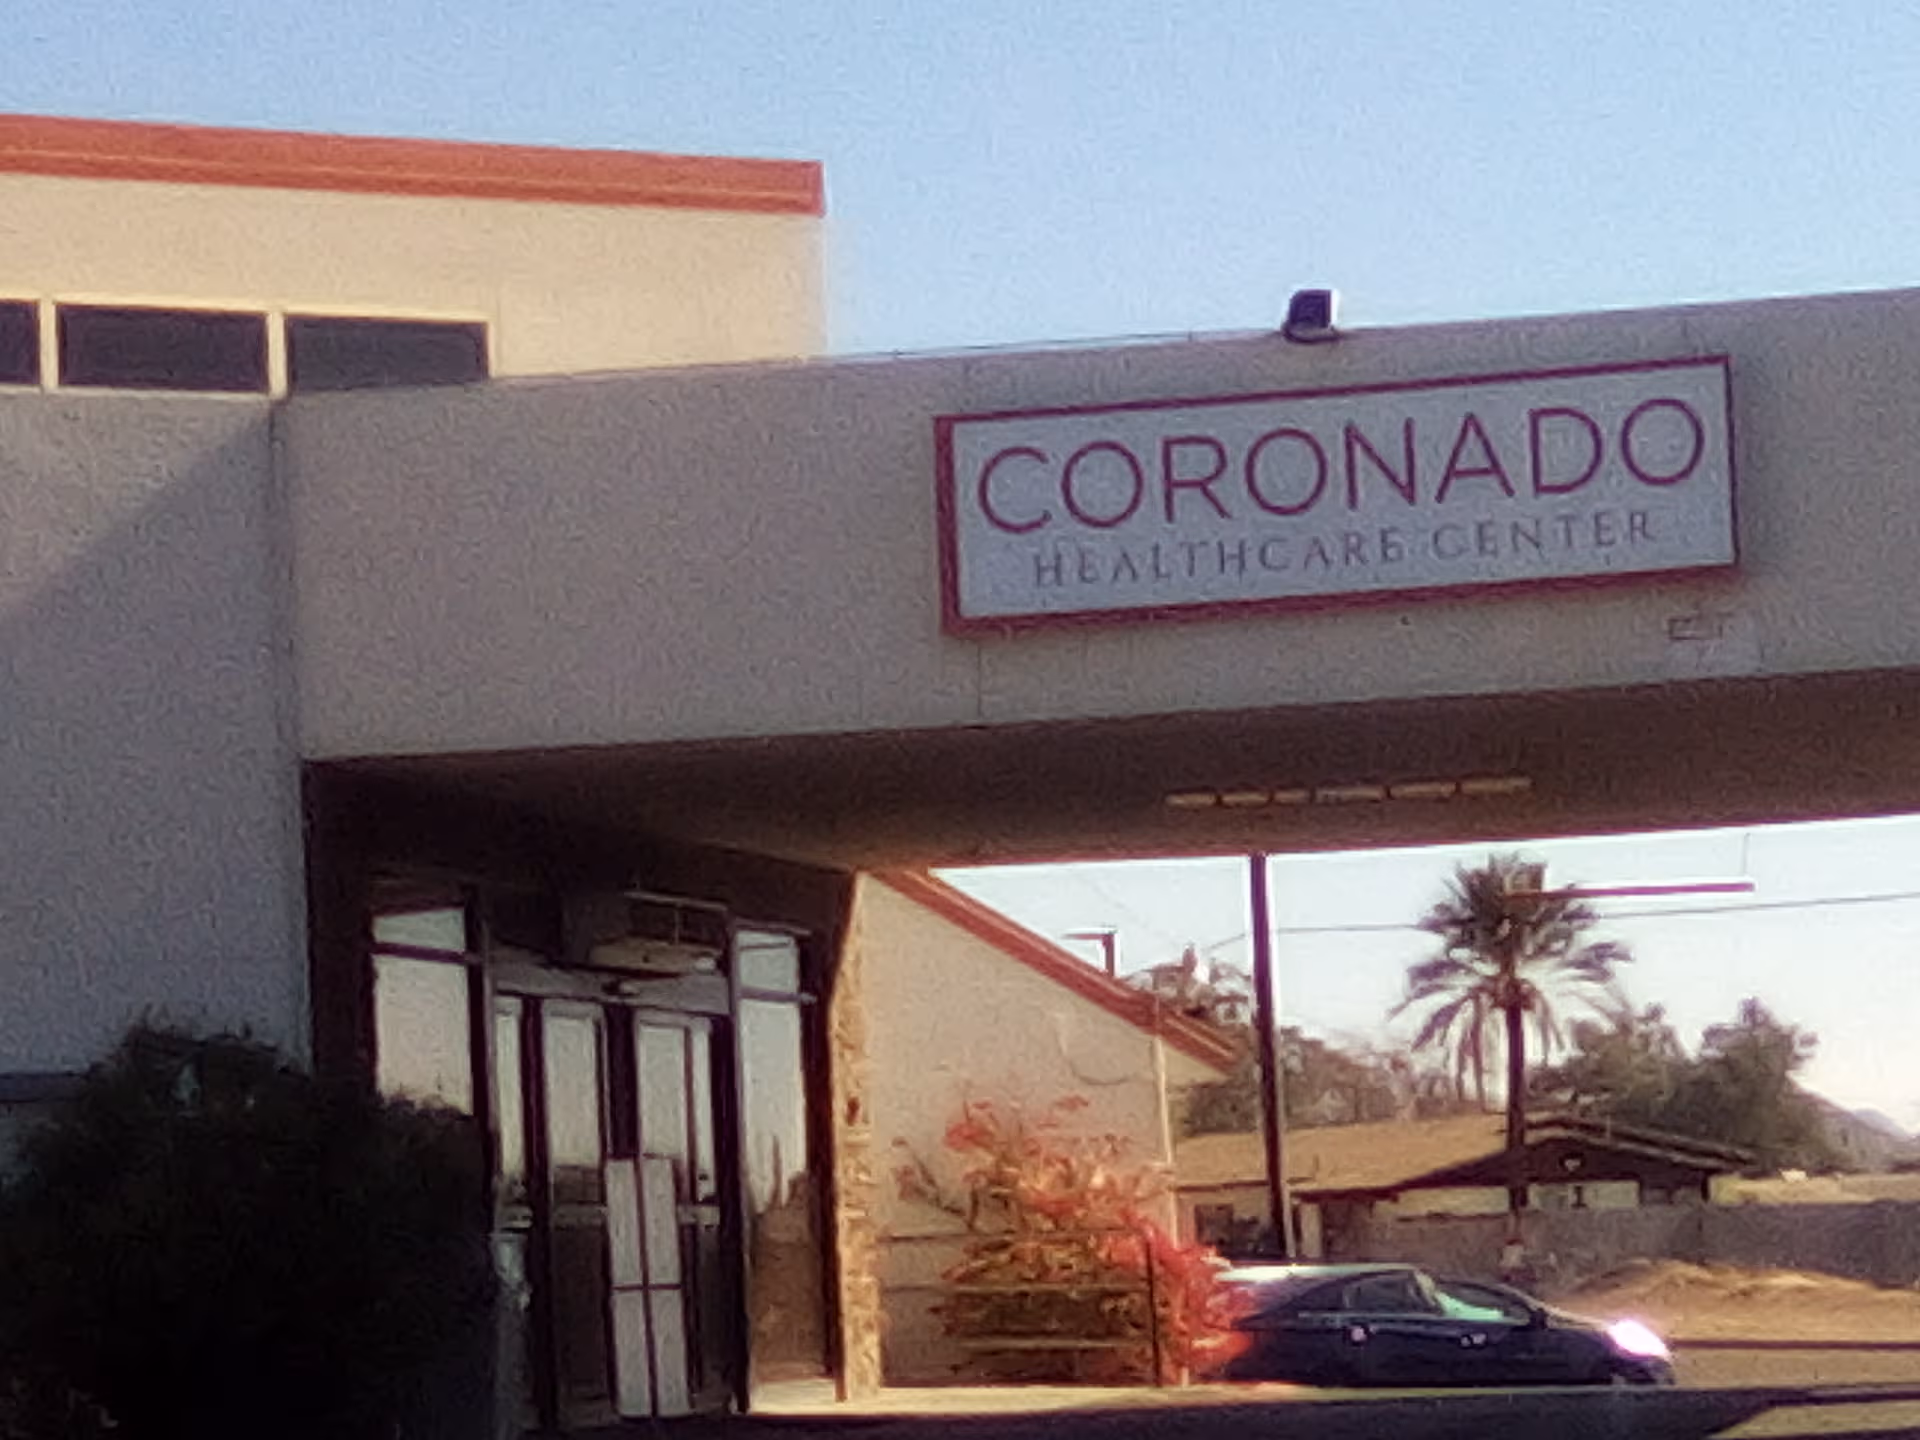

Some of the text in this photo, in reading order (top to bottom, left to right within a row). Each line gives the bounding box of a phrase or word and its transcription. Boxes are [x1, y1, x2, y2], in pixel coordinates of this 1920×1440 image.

[979, 398, 1705, 534] CORONADO
[1034, 511, 1655, 587] HEALTHCARE CENTER
